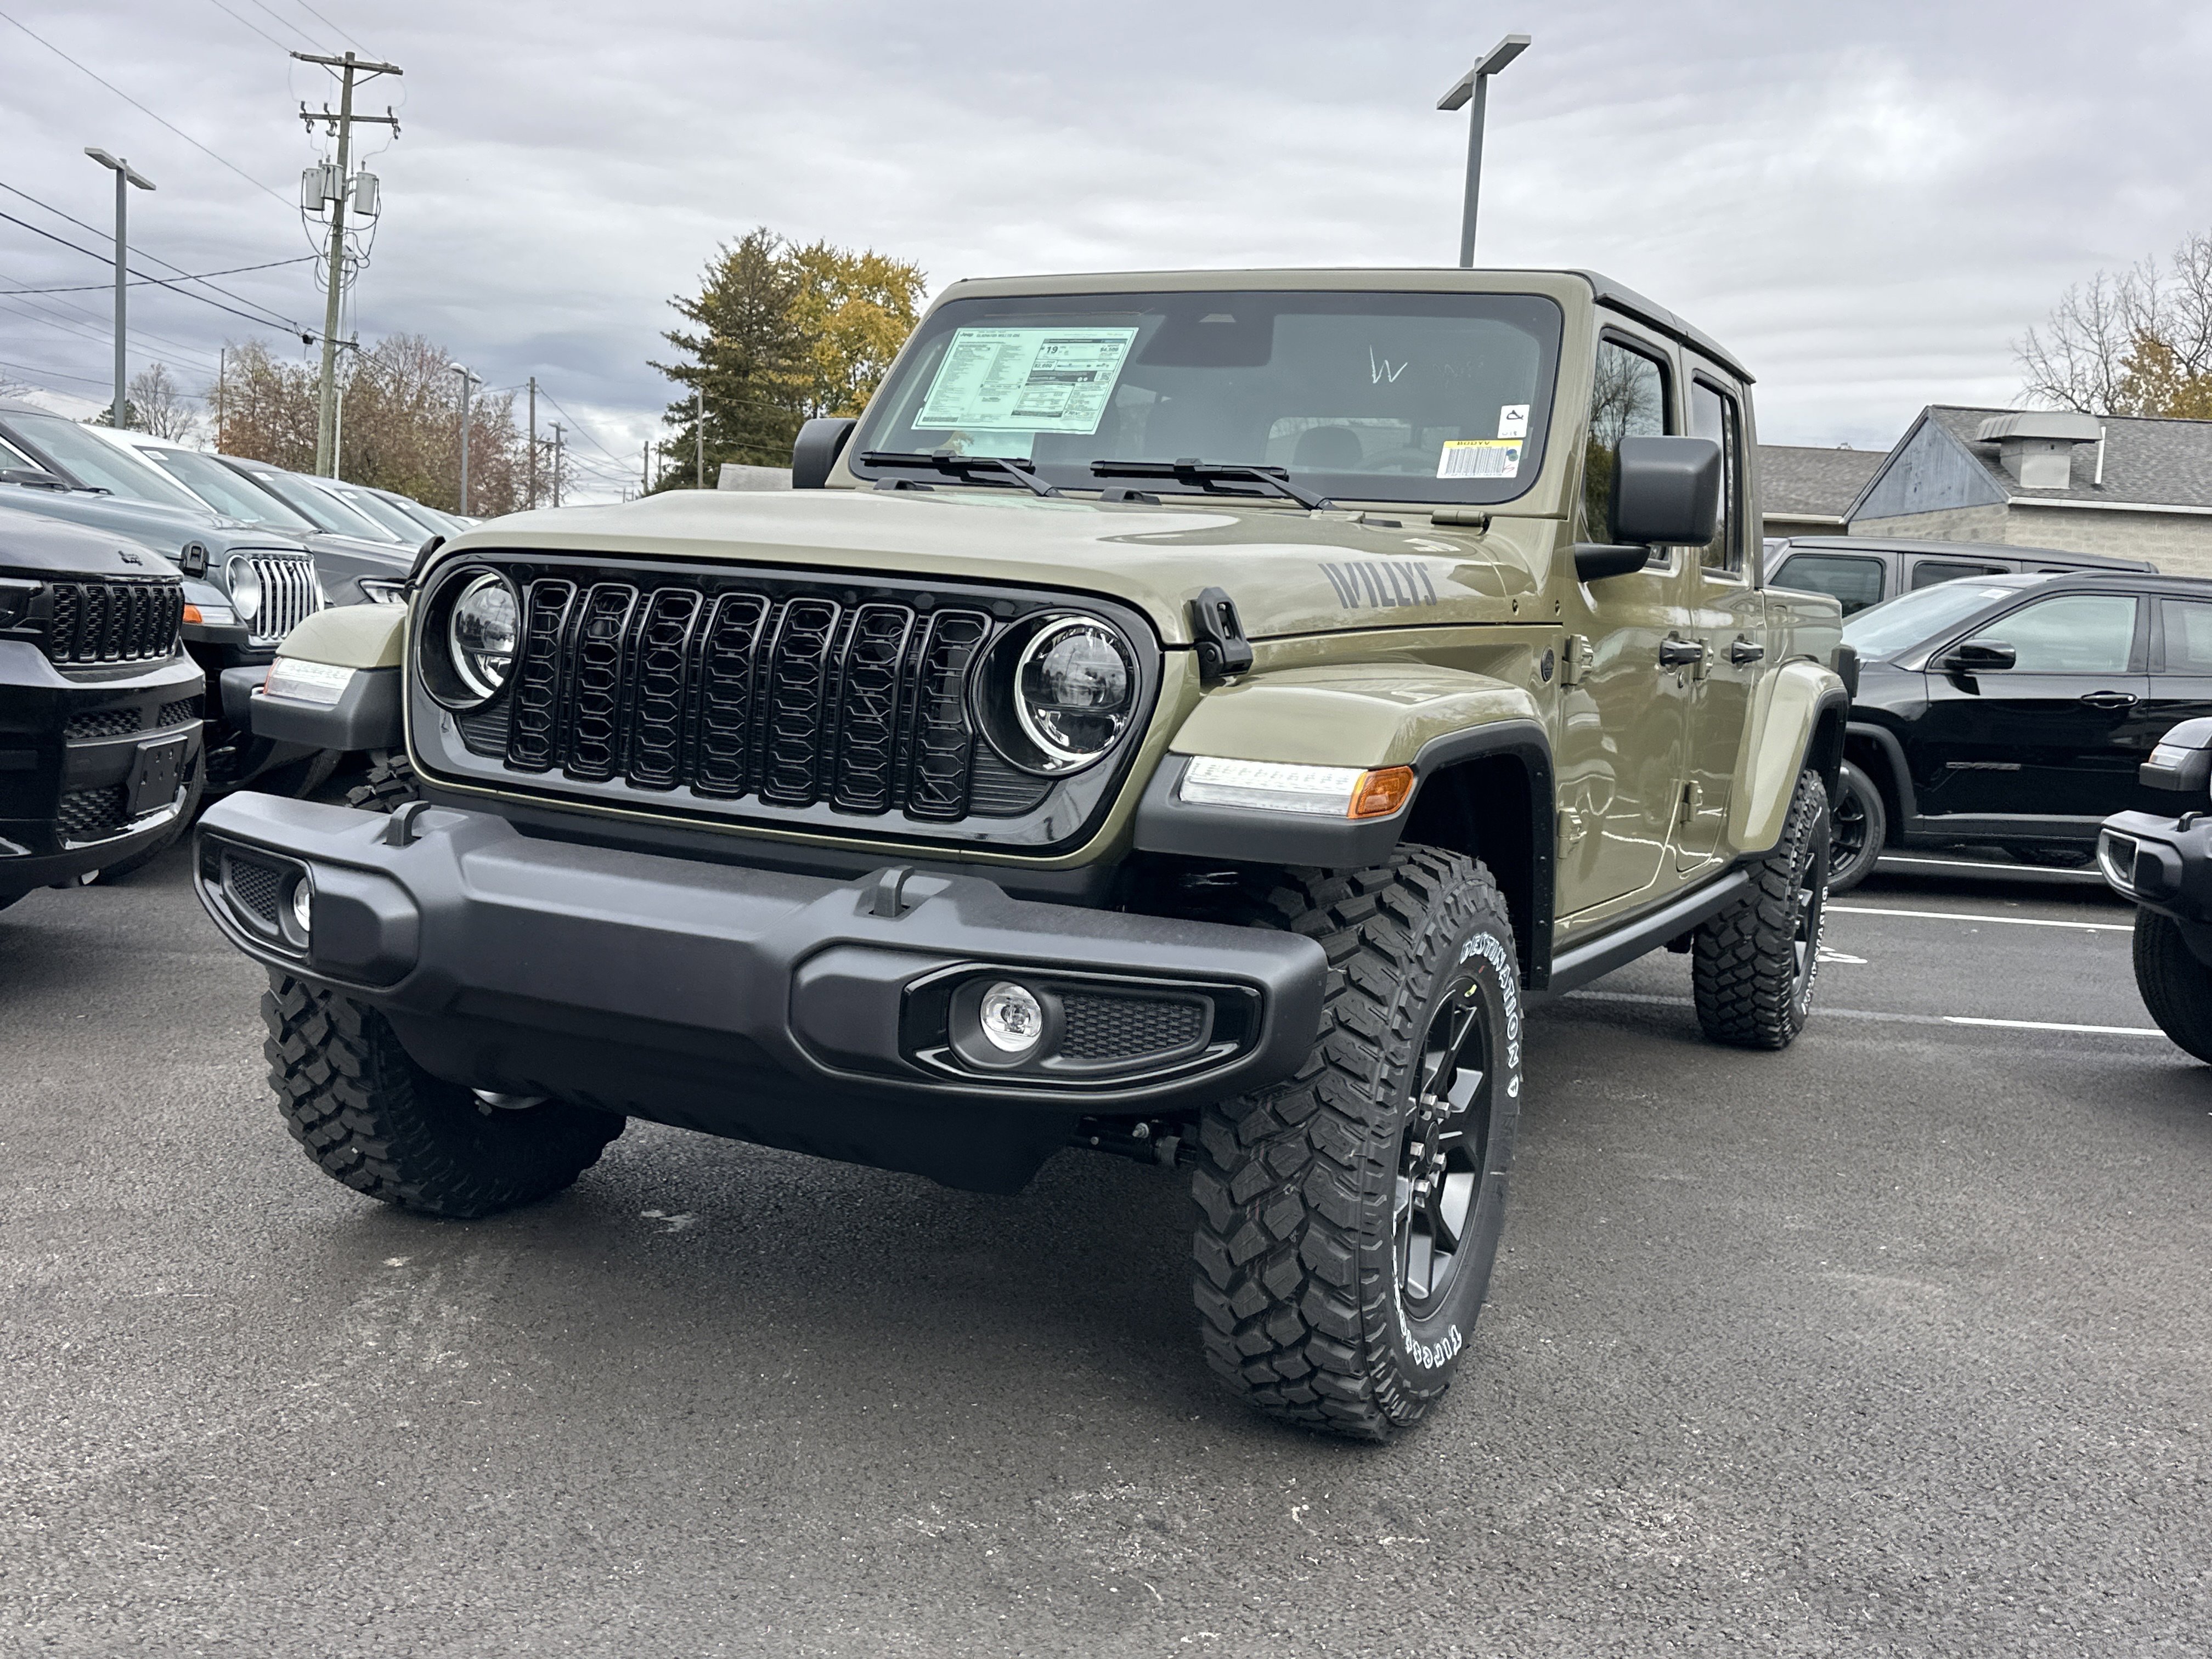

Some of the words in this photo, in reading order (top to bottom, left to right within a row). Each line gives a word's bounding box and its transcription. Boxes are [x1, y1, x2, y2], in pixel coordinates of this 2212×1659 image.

[1046, 346, 1058, 354] 19
[1369, 344, 1408, 384] W
[1317, 561, 1438, 609] WILLYS
[1460, 931, 1520, 1069] DESTINATION
